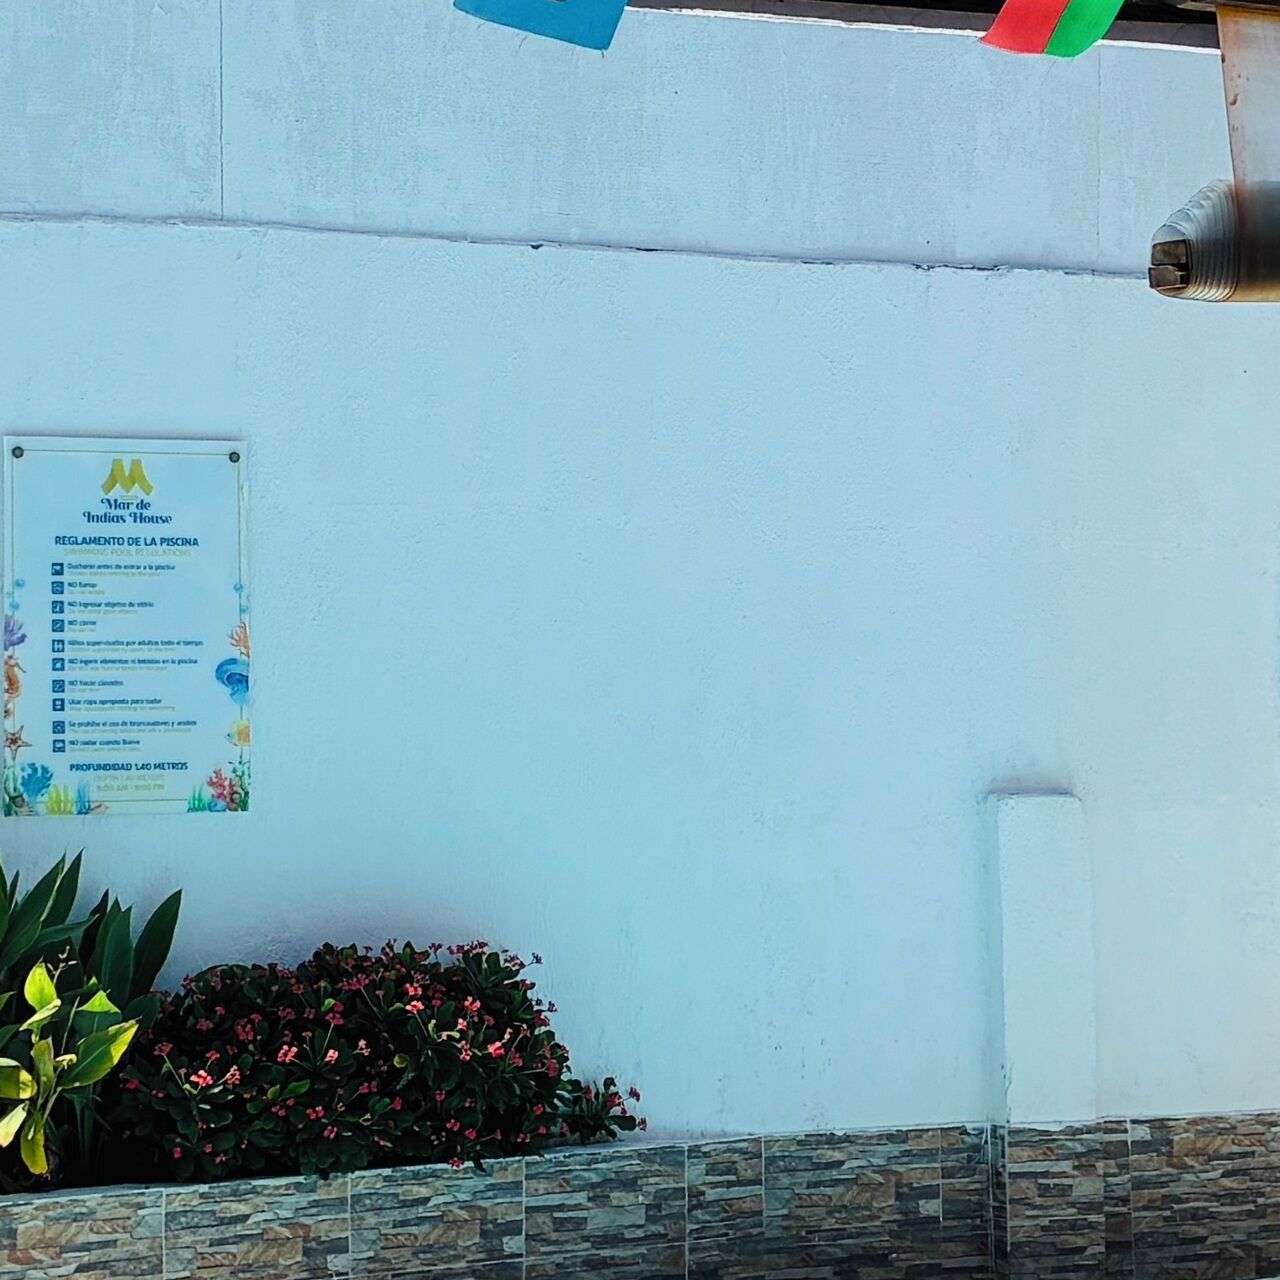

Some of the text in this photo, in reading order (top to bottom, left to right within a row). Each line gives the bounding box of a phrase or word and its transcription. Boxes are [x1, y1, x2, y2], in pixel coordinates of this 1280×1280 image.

[100, 498, 151, 510] Mar de
[83, 511, 172, 524] Indias House
[55, 536, 199, 546] REGLAMENTO DE LA PISCINA
[70, 763, 132, 771] PROFUNDIDAD
[153, 762, 188, 770] METROS
